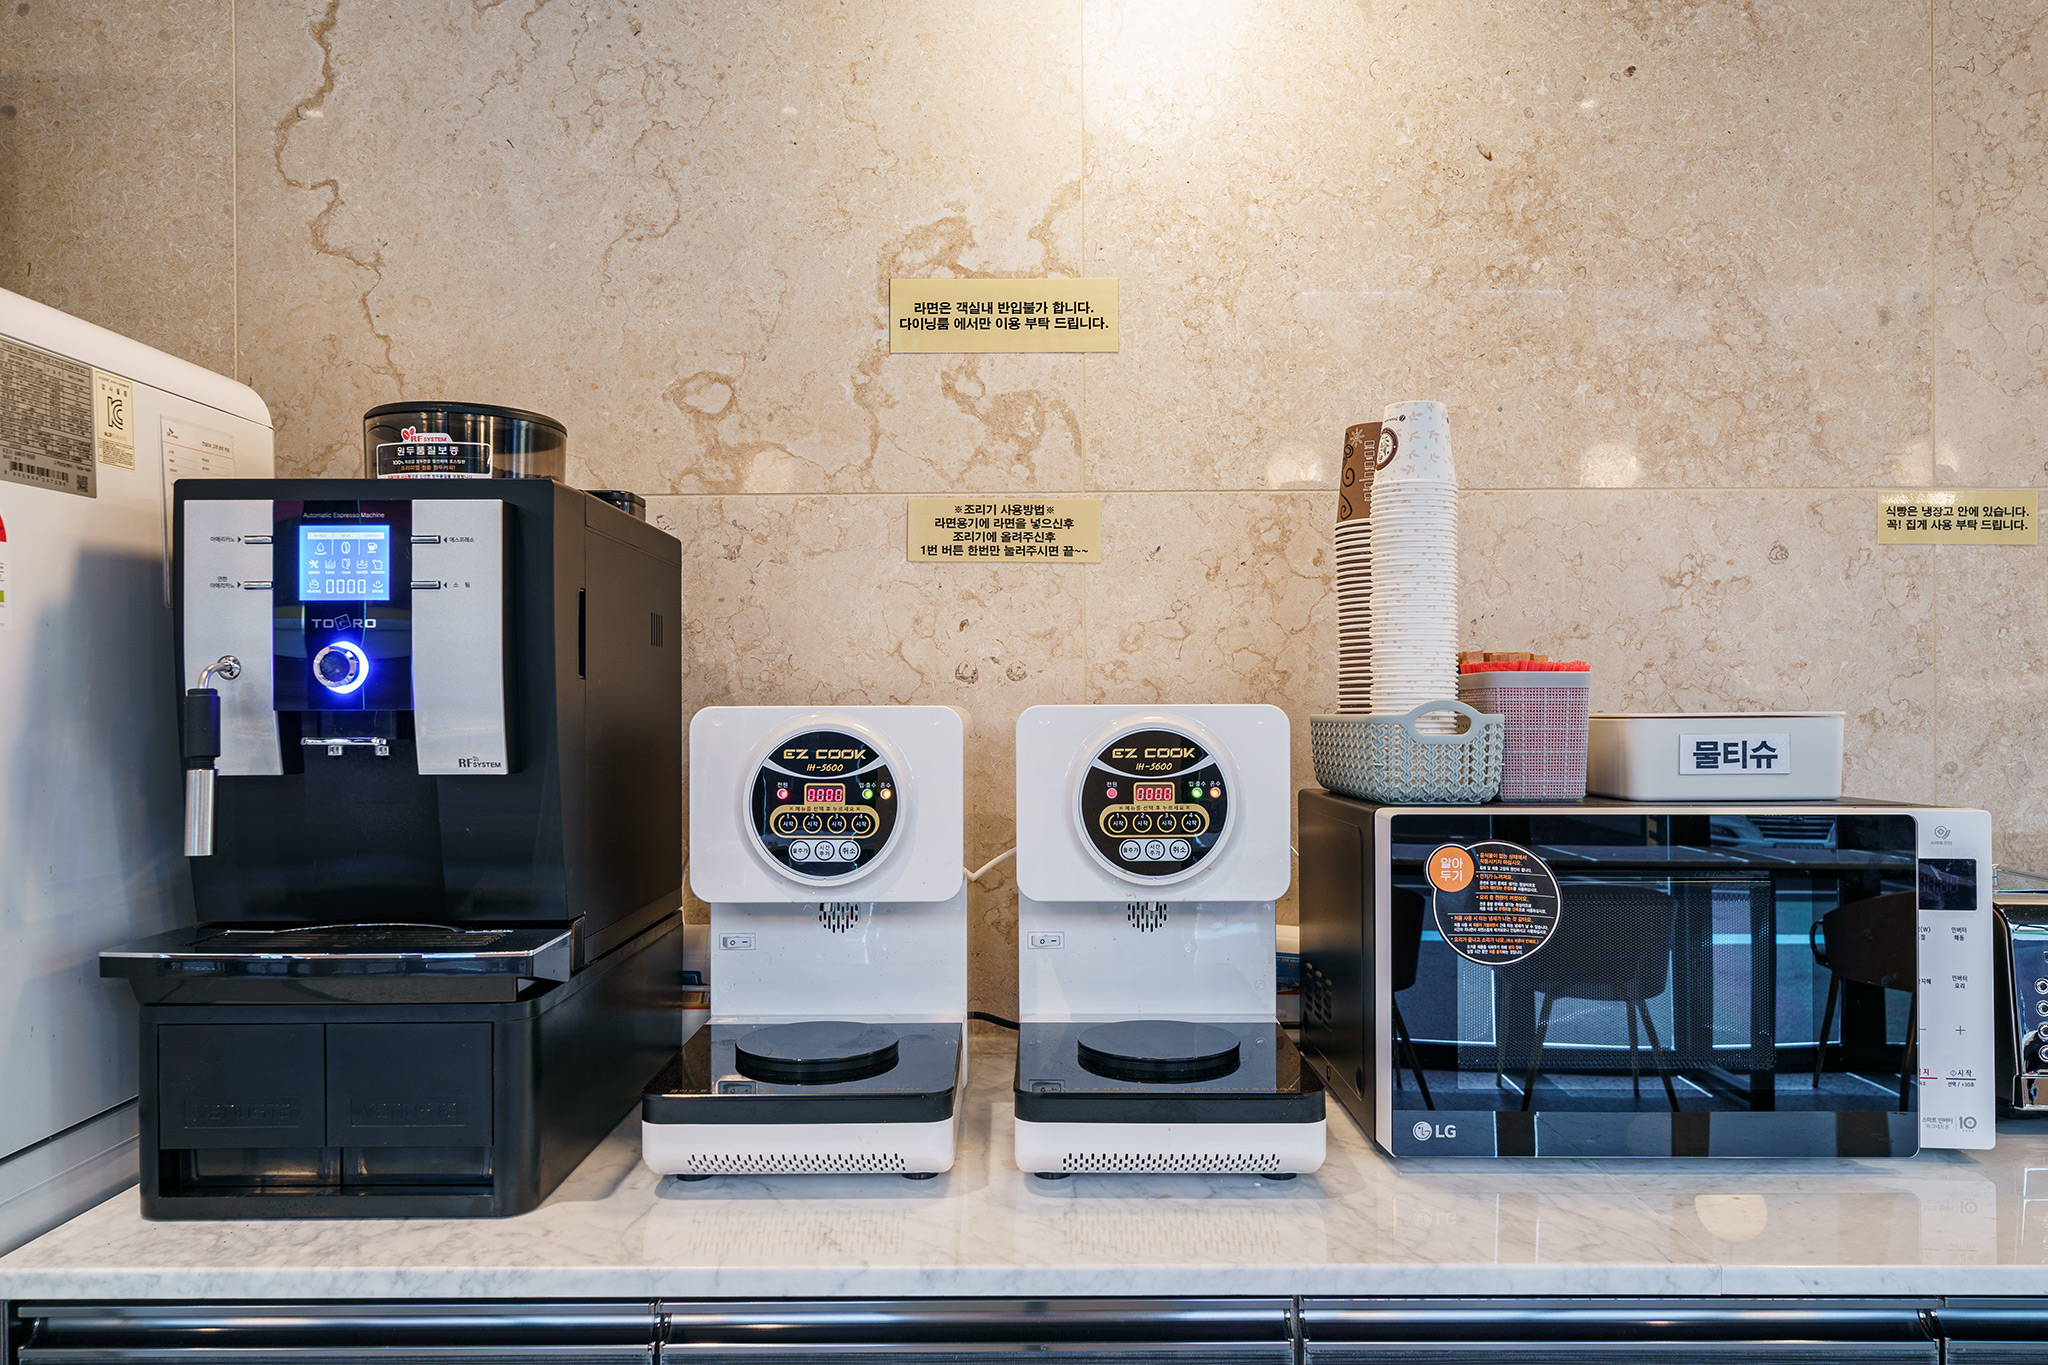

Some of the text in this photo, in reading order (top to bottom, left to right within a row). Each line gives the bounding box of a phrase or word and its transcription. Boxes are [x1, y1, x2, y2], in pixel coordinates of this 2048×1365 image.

[914, 302, 1094, 314] 라면은 객실내 반입불가 합니다.
[899, 317, 1110, 330] 다이닝룸 에서만 이용 부탁 드립니다.
[1886, 506, 2030, 517] 식빵은 냉장고 안에 있습니다.
[934, 517, 1074, 530] 라면용기에 라면을 넣으신후
[1886, 519, 2028, 530] 꼭! 집게 사용 부탁 드립니다.
[952, 531, 1056, 544] 조리기에 올려주신후
[920, 544, 1089, 558] 1번 버튼 한번만 눌러주시면 끝~~
[783, 749, 867, 760] EZ COOK
[1112, 748, 1196, 758] EZ COOK
[1692, 740, 1778, 770] 물티슈
[806, 764, 844, 772] IH-5600
[1136, 762, 1173, 771] IH-5600
[806, 788, 844, 802] 0000
[1136, 787, 1172, 801] 0000
[1173, 846, 1186, 854] 취소
[1440, 858, 1464, 868] 알아
[1440, 871, 1463, 882] 두기
[1435, 1124, 1457, 1138] LG
